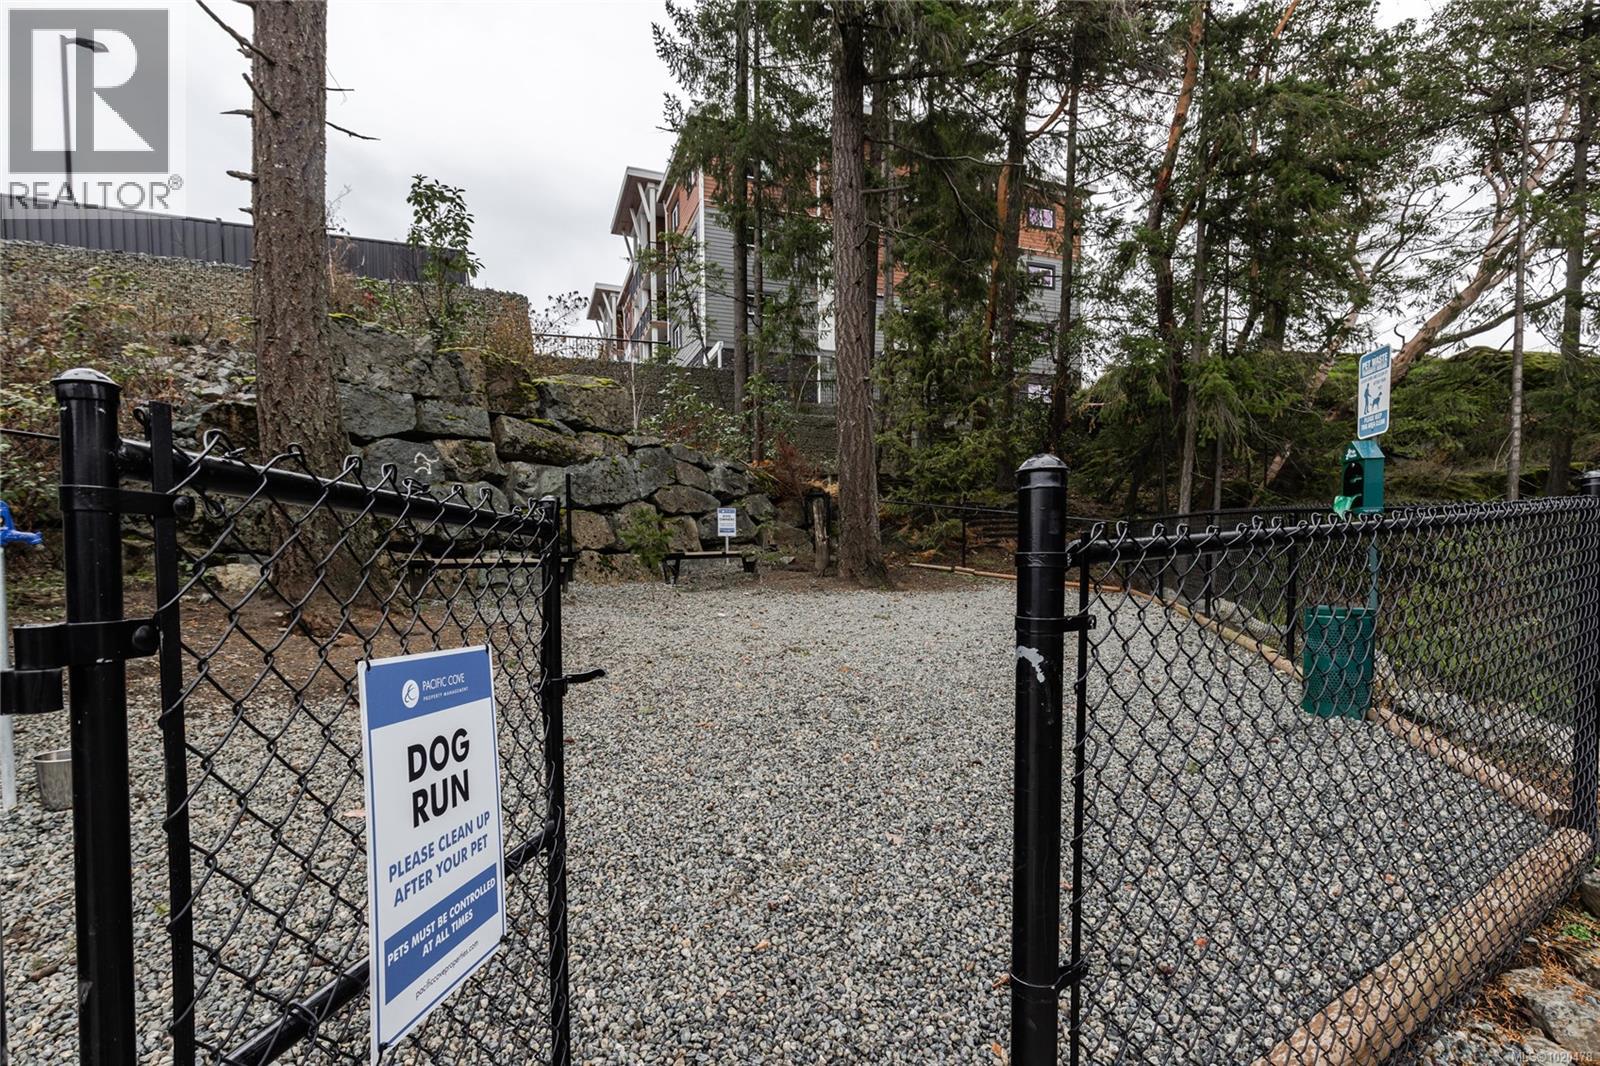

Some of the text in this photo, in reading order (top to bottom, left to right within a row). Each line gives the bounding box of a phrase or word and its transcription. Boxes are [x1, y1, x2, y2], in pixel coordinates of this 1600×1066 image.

[422, 672, 465, 692] PACIFIC COVE
[423, 686, 469, 702] PROPERTY MANAGEMENT
[407, 728, 470, 783] DOG
[412, 769, 470, 829] RUN
[388, 811, 491, 883] PLEASE CLEAN UP
[393, 834, 488, 908] AFTER YOUR PET
[387, 877, 496, 967] PETS MUST BE CONTROLLED
[422, 908, 474, 958] AT ALL TIMES
[415, 940, 479, 1001] pacificcoveproperties.com
